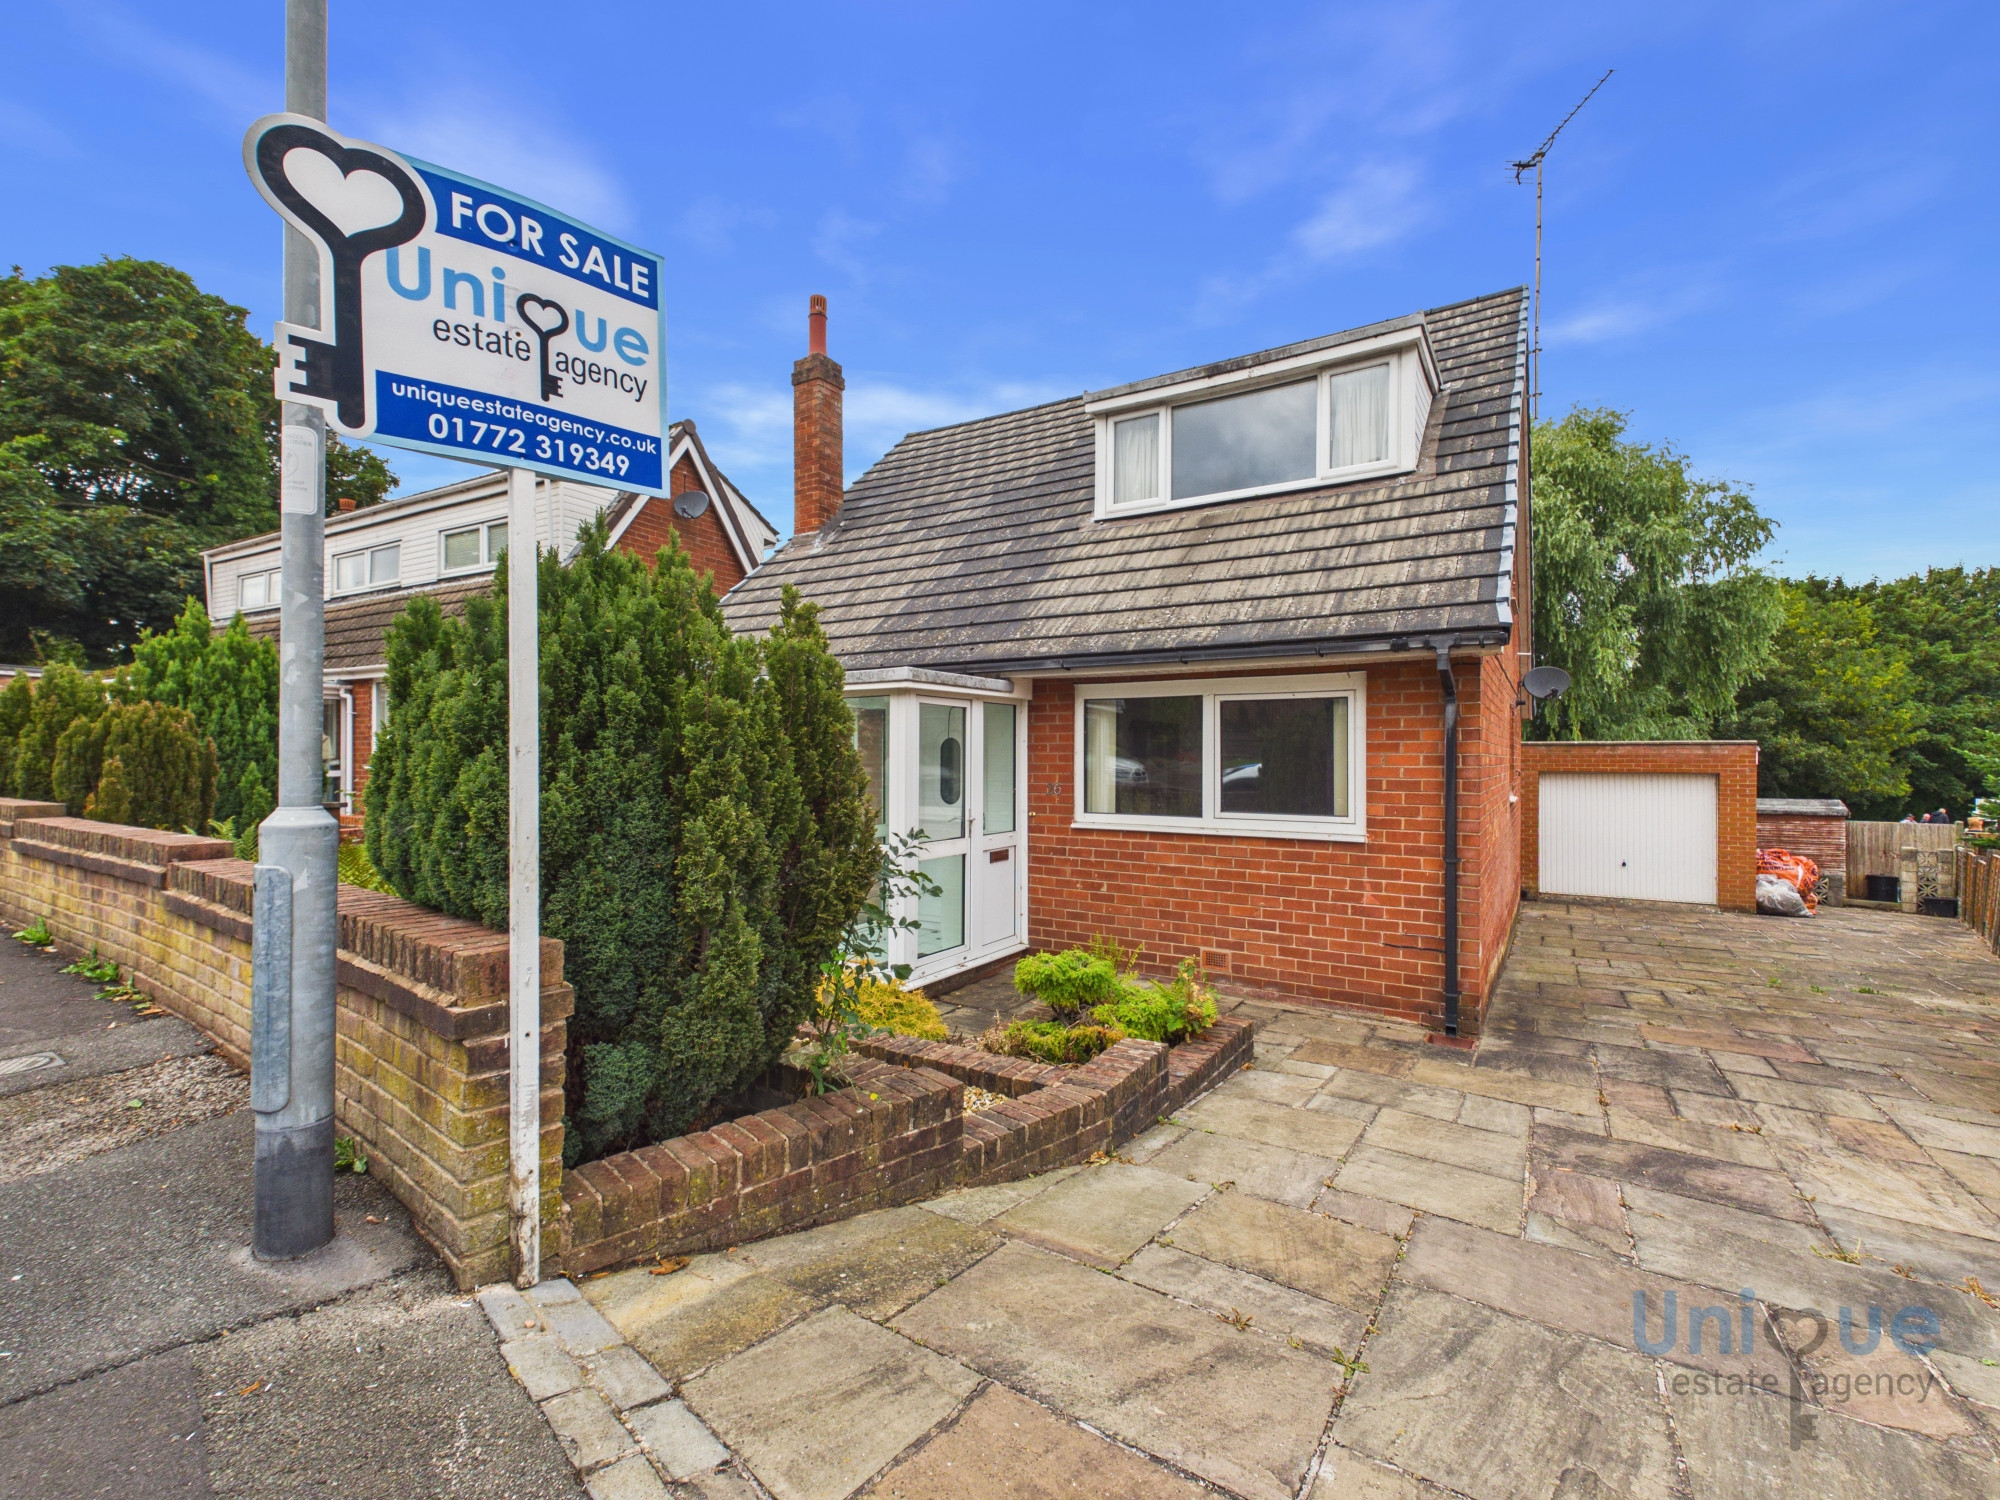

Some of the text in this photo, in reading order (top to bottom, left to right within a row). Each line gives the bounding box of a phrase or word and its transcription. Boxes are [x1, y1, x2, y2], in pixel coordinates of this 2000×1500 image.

[452, 191, 649, 298] FOR SALE
[433, 318, 648, 402] estate agency
[391, 382, 657, 455] uniqueestateagency.co.uk
[428, 413, 630, 477] 01772 319349
